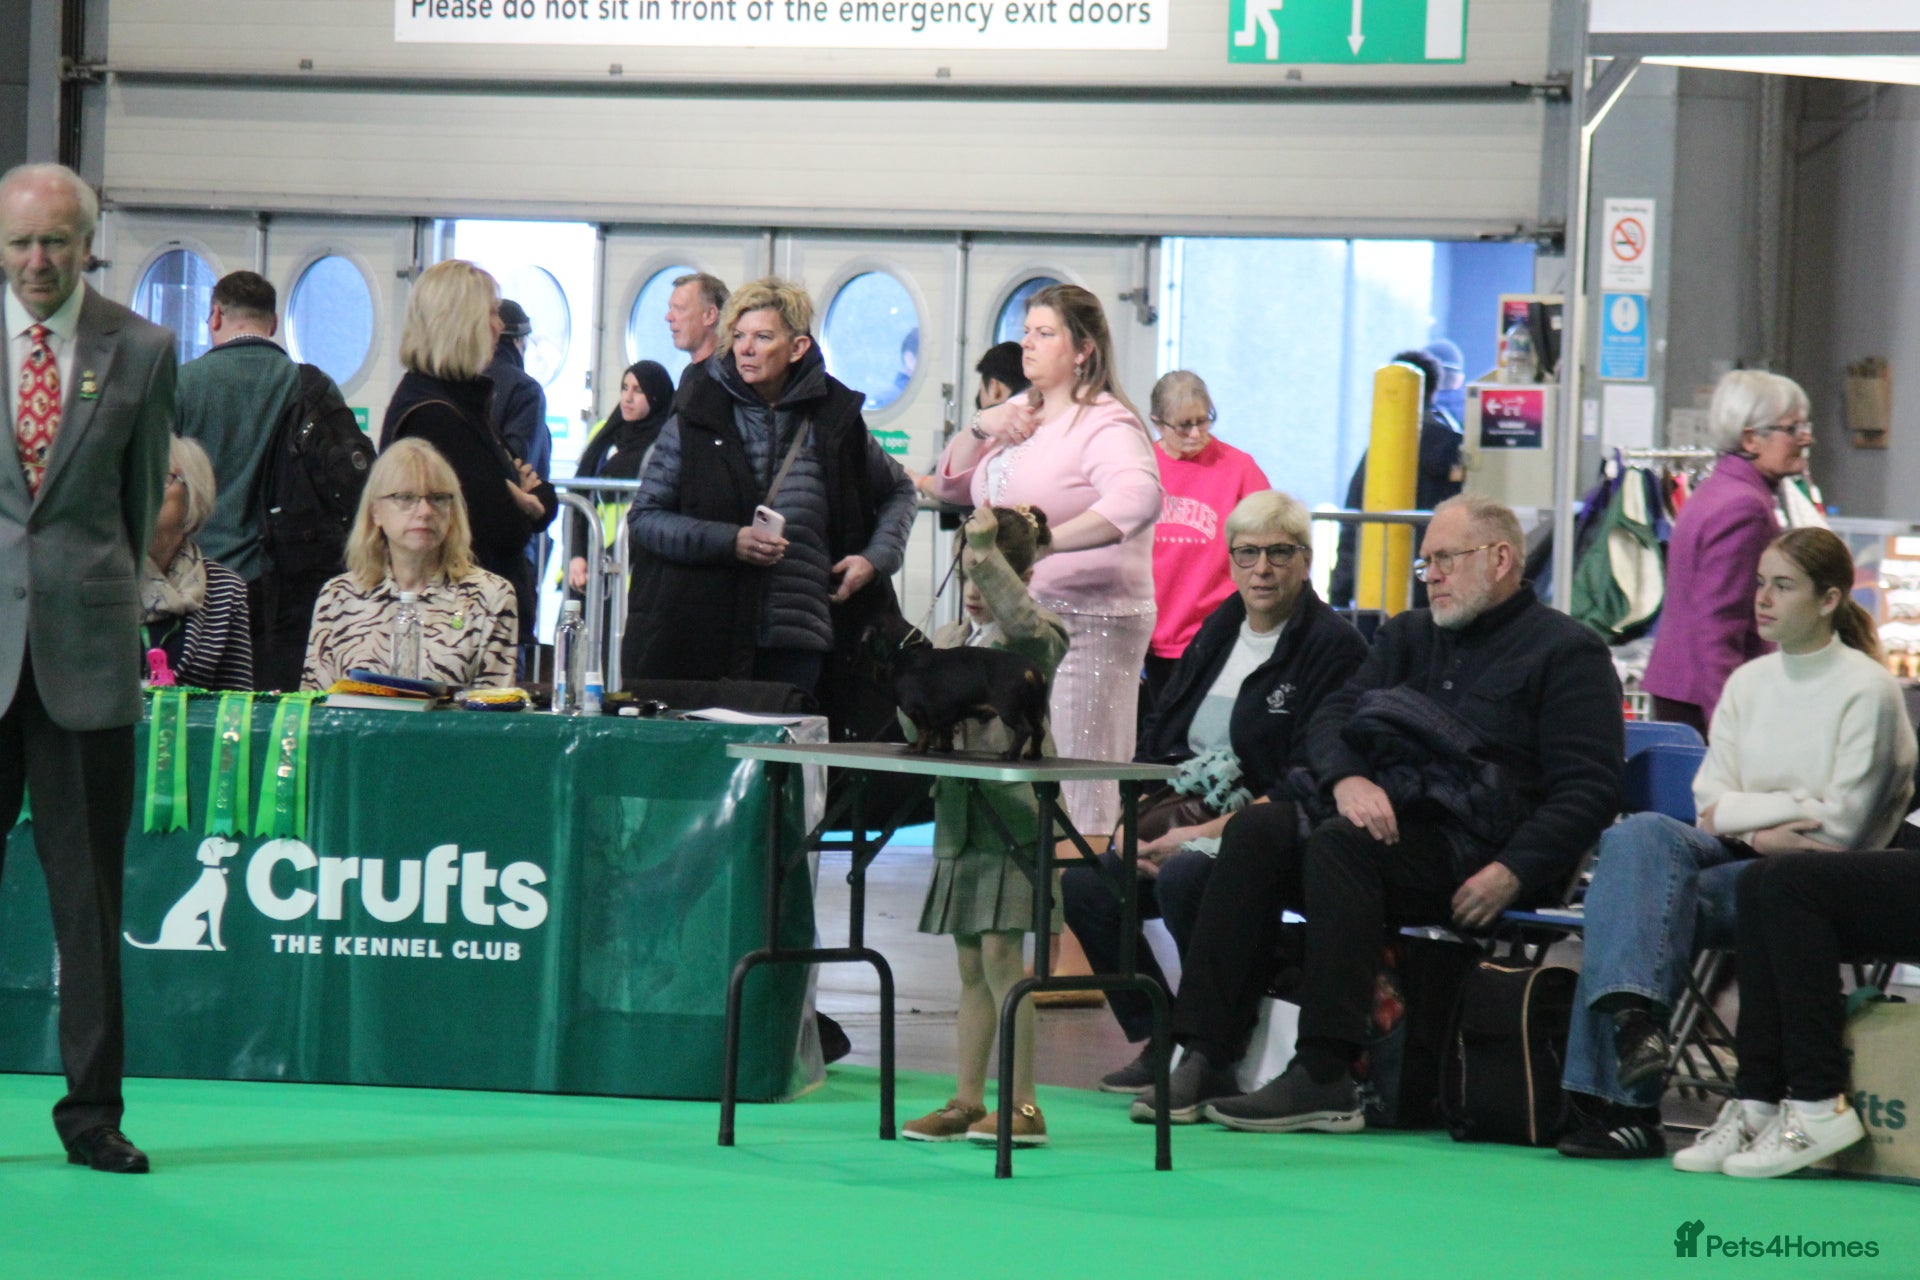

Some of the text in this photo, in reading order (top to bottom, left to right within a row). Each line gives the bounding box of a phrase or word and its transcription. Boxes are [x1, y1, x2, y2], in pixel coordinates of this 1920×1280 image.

[411, 0, 1150, 32] Please do not sit in front of the emergency exit doors
[1156, 495, 1218, 541] NGELES
[246, 838, 548, 930] Crufts
[271, 934, 521, 961] THE KENNEL CLUB
[1856, 1090, 1906, 1130] fts
